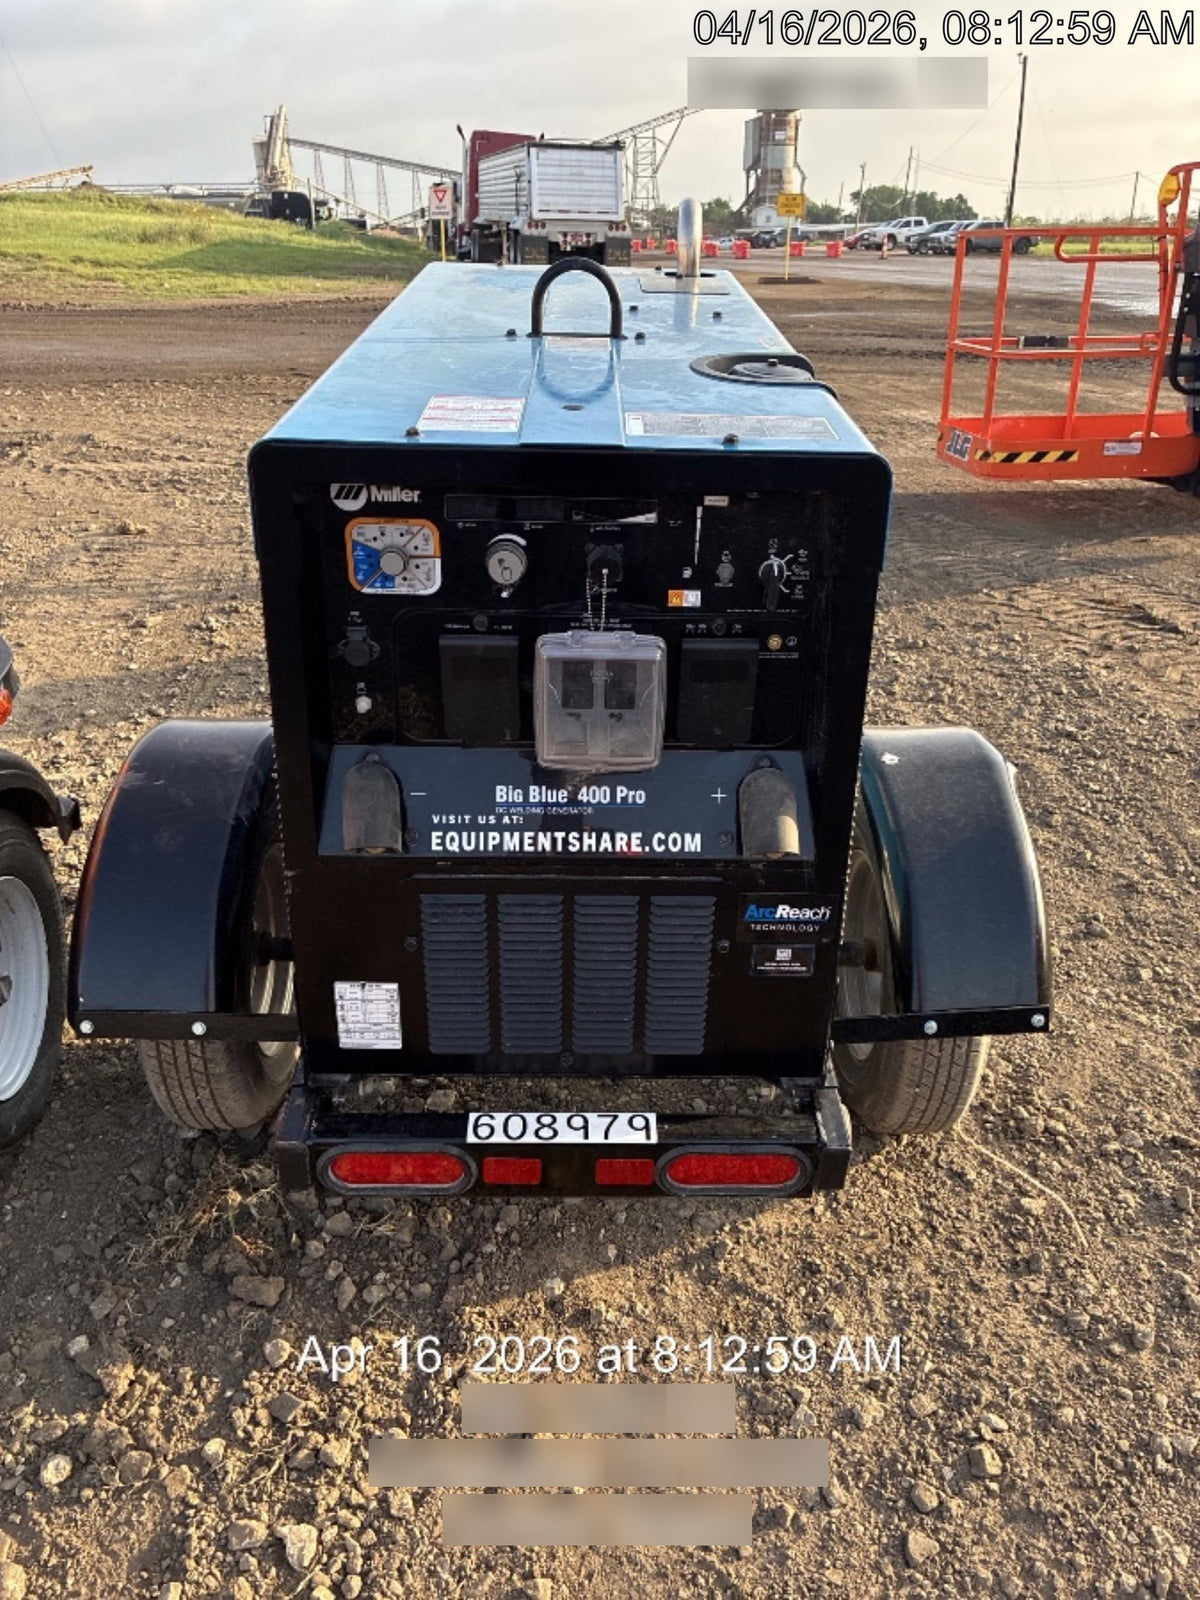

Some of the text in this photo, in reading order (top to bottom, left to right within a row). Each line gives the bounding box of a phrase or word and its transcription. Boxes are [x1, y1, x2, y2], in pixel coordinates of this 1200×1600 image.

[945, 429, 974, 461] JLG
[370, 484, 421, 503] Miller
[495, 785, 645, 804] Big Blue 400 Pro
[431, 814, 524, 825] VISIT US AT:
[430, 831, 702, 853] EQUIPMENTSHARE.COM
[744, 904, 831, 919] ArcReach
[750, 923, 820, 932] TECHNOLOGY
[472, 1113, 652, 1140] 608979
